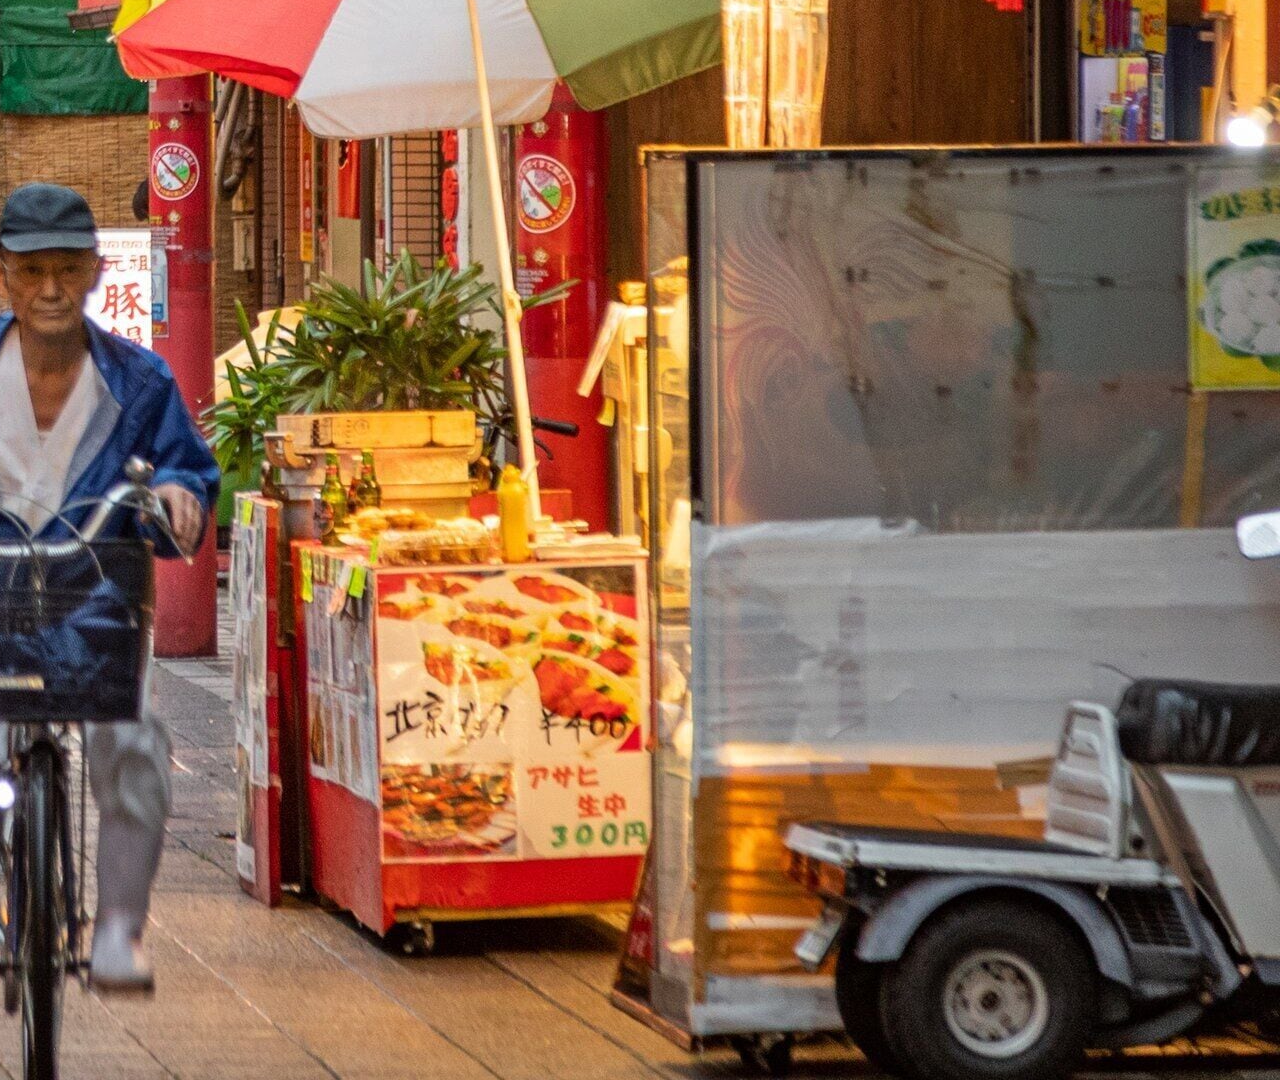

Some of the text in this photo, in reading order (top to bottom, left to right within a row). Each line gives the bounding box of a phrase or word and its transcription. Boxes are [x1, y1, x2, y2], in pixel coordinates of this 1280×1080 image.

[539, 708, 627, 746] ¥400
[527, 765, 600, 790] アサヒ
[577, 793, 628, 819] 生中
[551, 821, 649, 849] 300円
